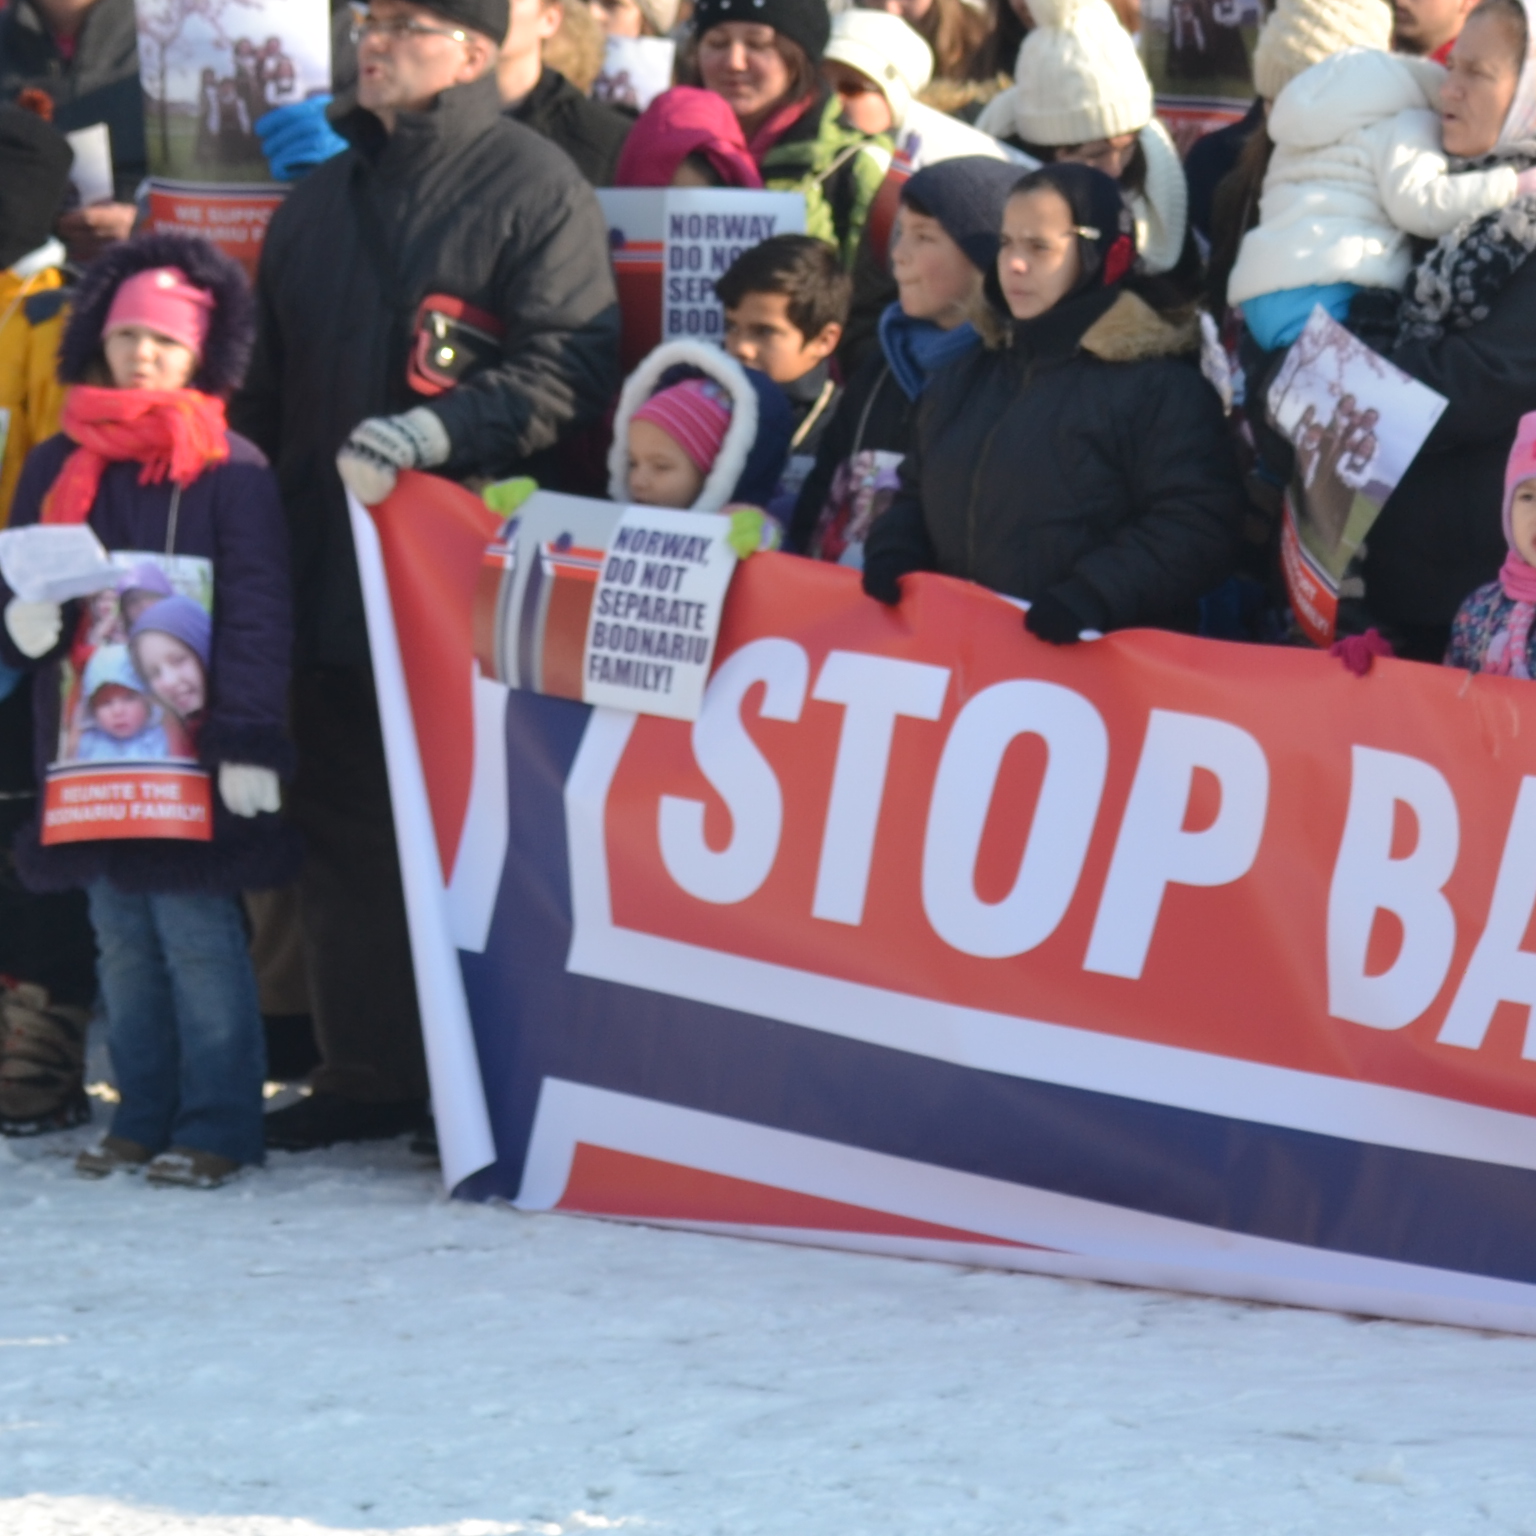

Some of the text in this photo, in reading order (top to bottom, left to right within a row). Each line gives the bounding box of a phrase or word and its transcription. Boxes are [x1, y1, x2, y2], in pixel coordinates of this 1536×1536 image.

[670, 245, 743, 271] DO NO
[613, 527, 712, 565] NORWAY,
[604, 556, 687, 593] DO NOT
[597, 589, 706, 631] SEPARATE
[592, 621, 709, 665] BODNARIU
[588, 654, 674, 694] FAMILY!
[140, 782, 180, 801] THE
[657, 636, 1271, 980] STOP
